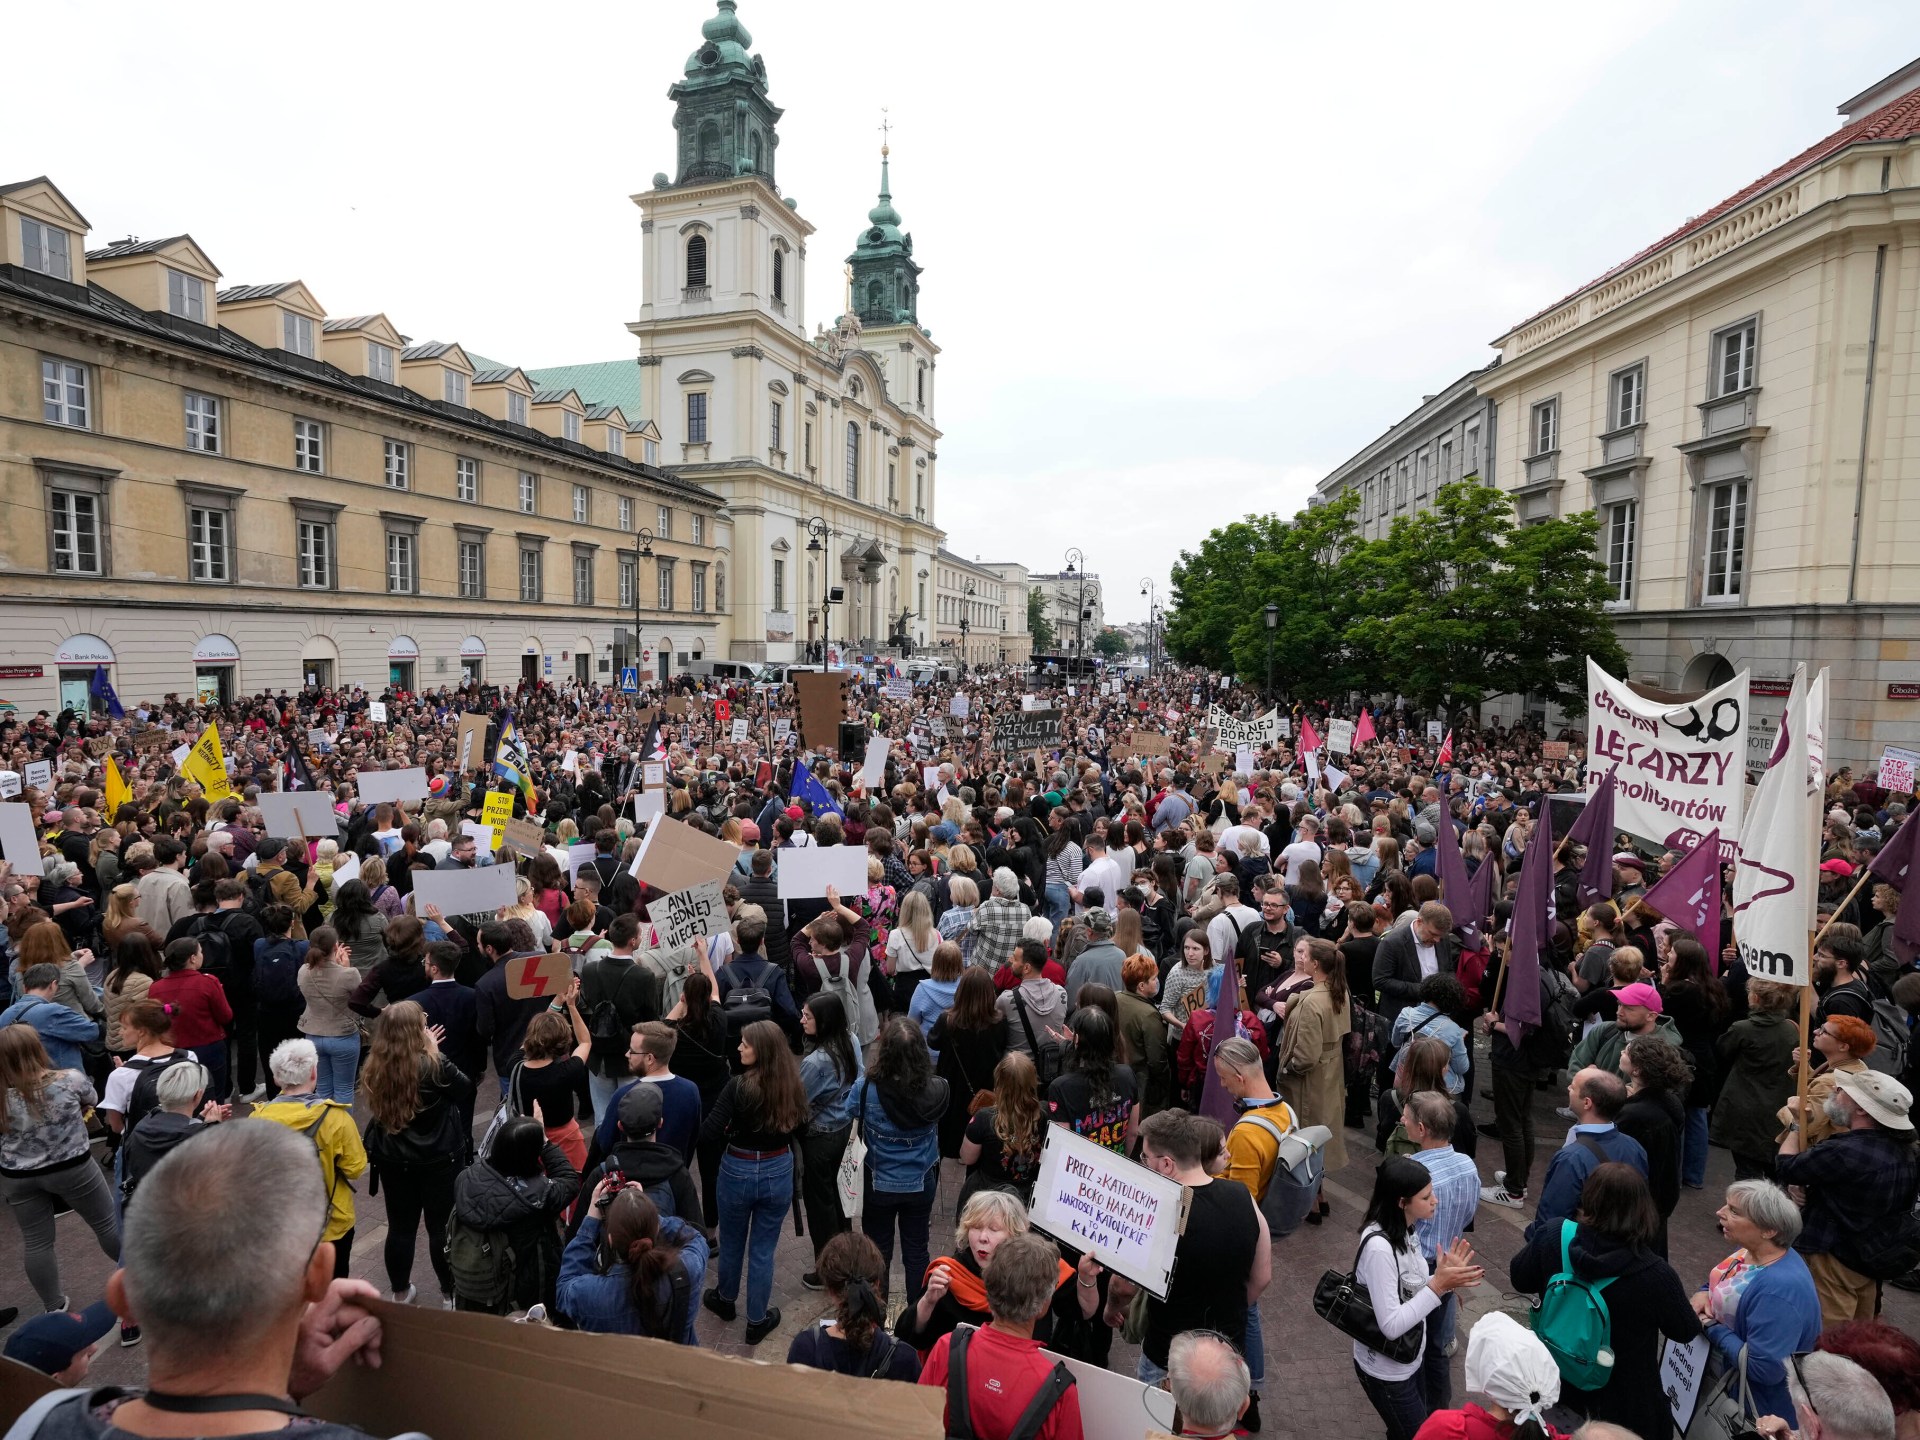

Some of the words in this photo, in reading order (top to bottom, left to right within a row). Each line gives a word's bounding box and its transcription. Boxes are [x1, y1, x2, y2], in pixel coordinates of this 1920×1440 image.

[994, 713, 1028, 725] STAN
[993, 719, 1062, 736] PRZEKLĘTY
[1221, 728, 1267, 741] BORCJI
[1885, 759, 1908, 770] STOP
[1879, 766, 1913, 780] VIOLENCE
[1882, 774, 1909, 785] AGAINST
[1881, 781, 1913, 794] WOMEN!
[497, 796, 510, 805] STOP
[490, 817, 507, 827] WOBE
[668, 890, 693, 913] ANI
[666, 900, 711, 931] JEDNEJ
[666, 918, 708, 949] WIĘCEJ
[1065, 1154, 1095, 1182] PRECZ
[1102, 1172, 1158, 1213] KATOLICKIM
[1077, 1182, 1104, 1206] BOKO
[1106, 1196, 1144, 1226] HARAM
[1088, 1219, 1099, 1230] TO
[1071, 1219, 1109, 1247] KŁAM
[1672, 1343, 1694, 1378] jednej
[1668, 1357, 1692, 1393] więcej!
